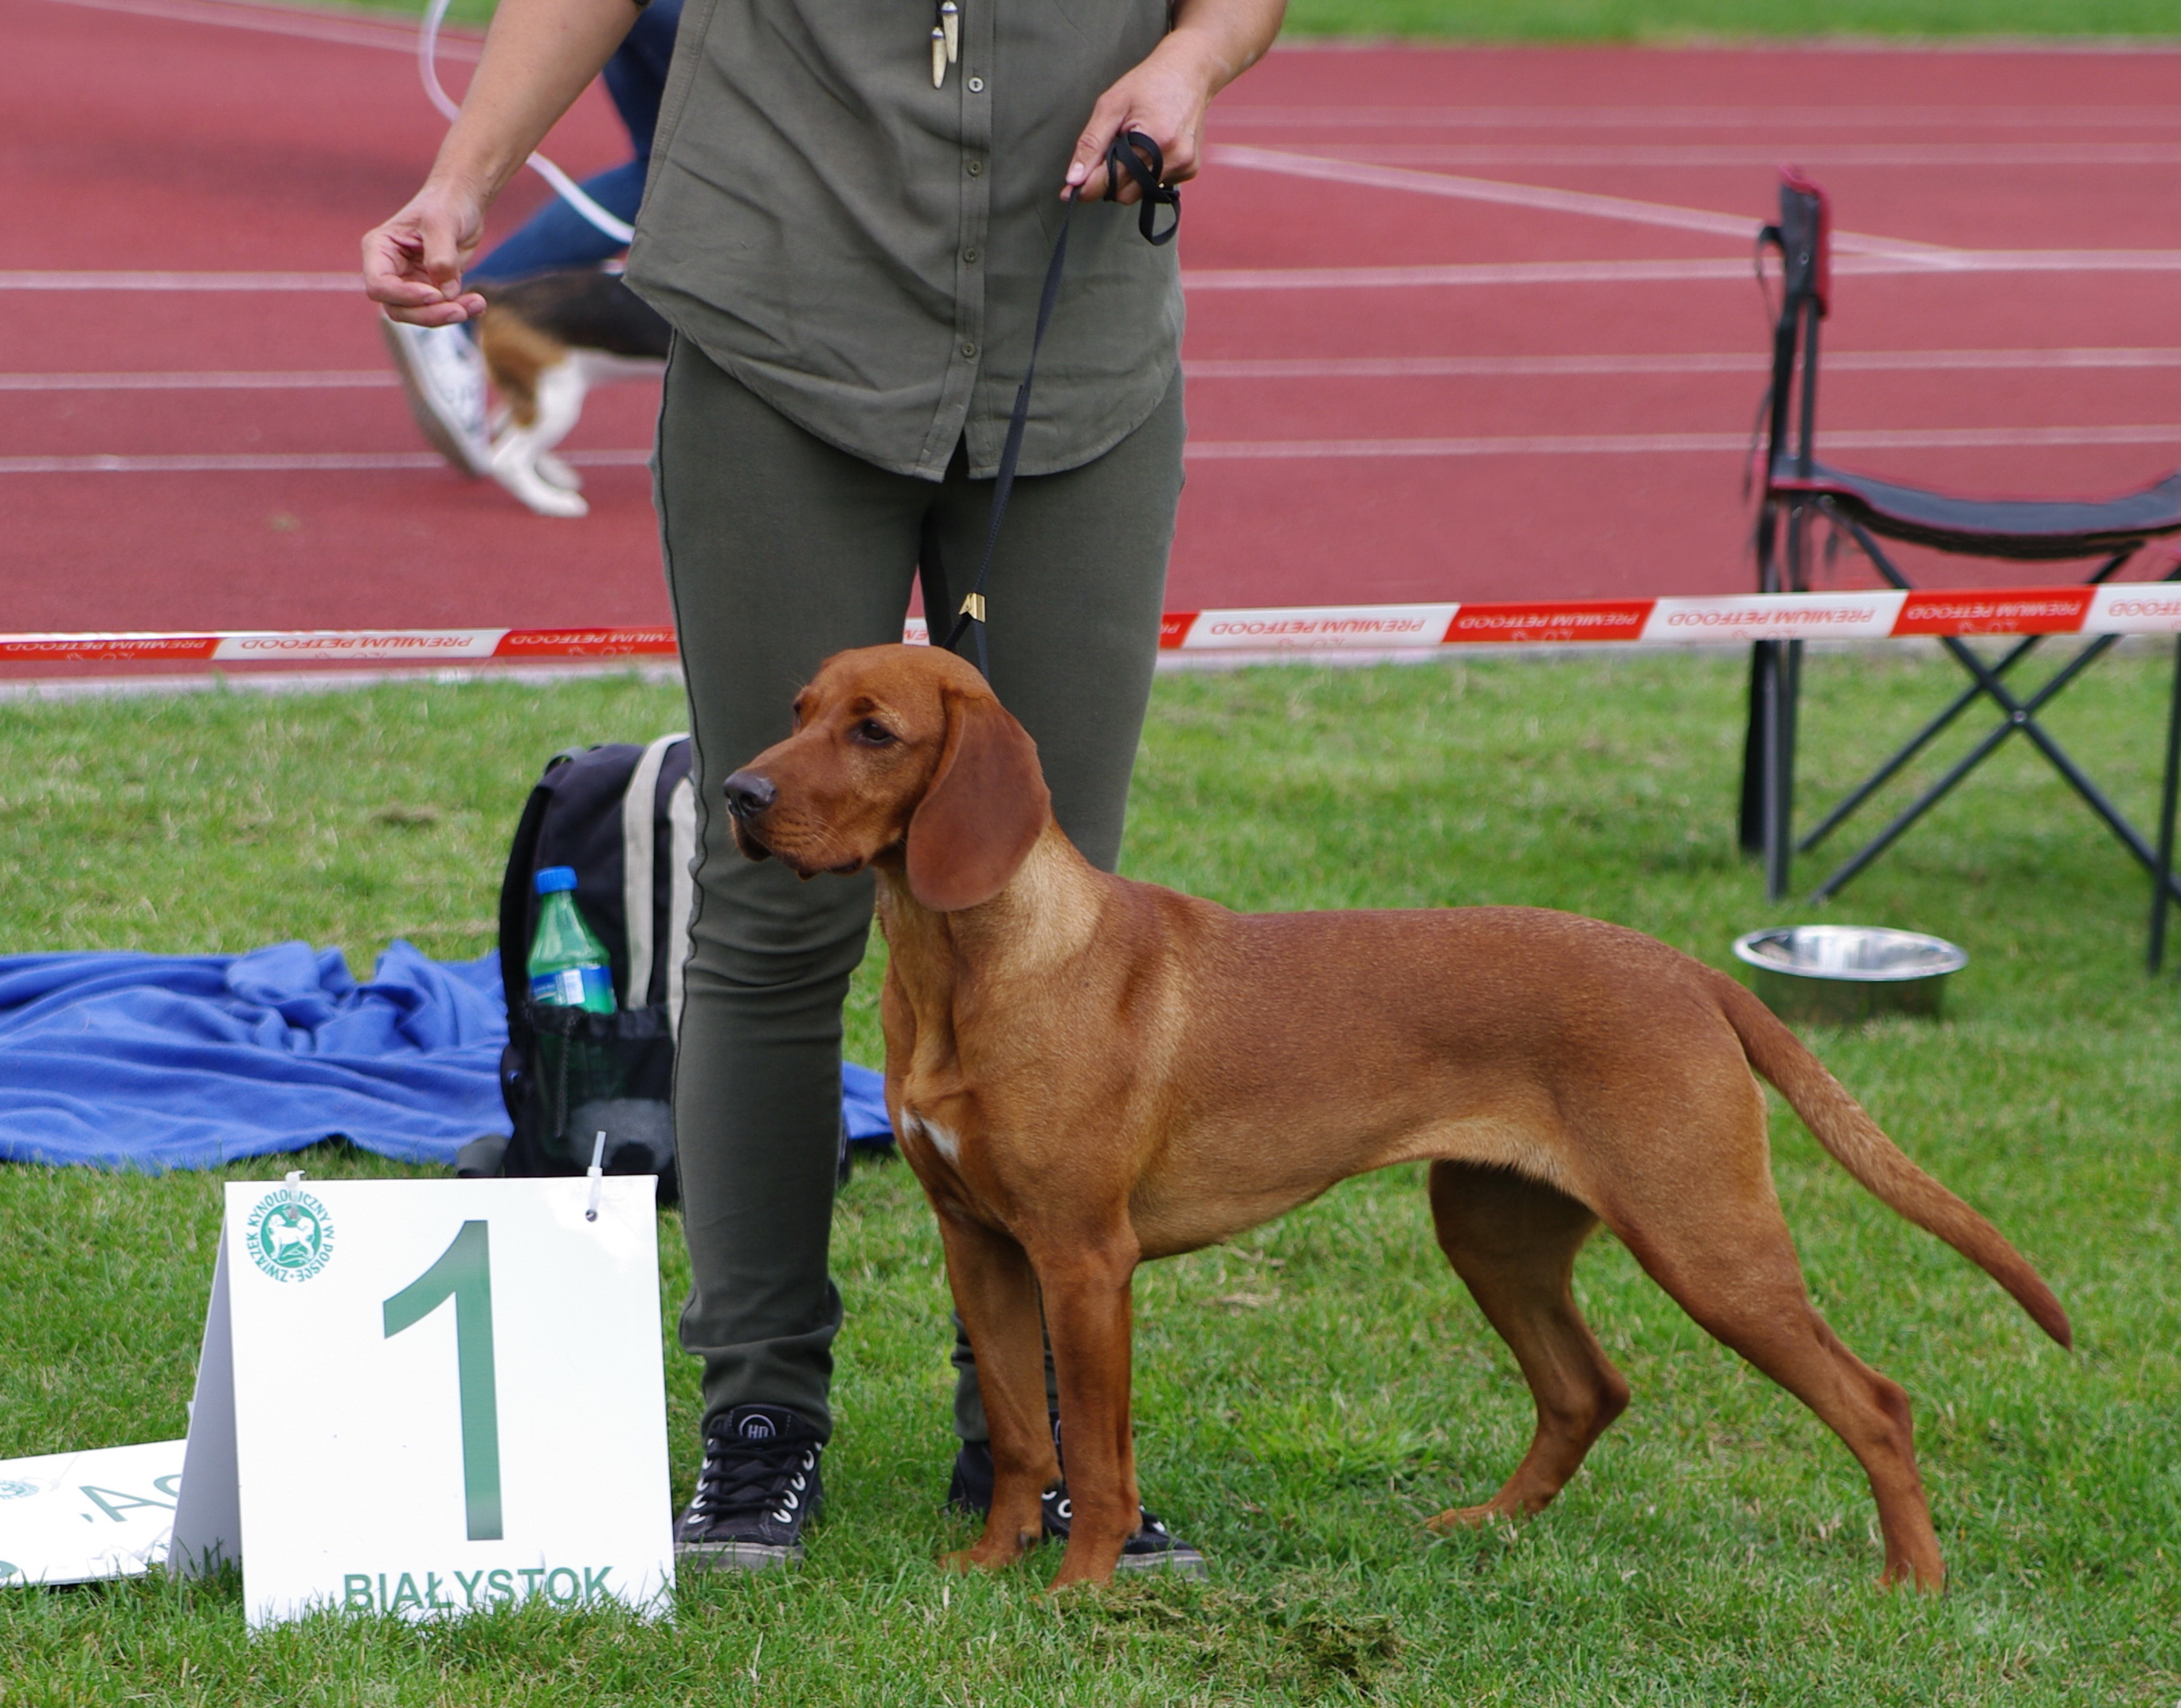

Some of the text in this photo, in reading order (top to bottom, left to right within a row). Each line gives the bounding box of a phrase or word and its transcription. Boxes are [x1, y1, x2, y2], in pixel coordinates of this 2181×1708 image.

[1907, 601, 2081, 618] PREMIUM PETFOOD
[2108, 600, 2181, 616] TFOOD
[1459, 613, 1639, 629] PREMIUM PETFOOD
[1668, 610, 1876, 626] PREMIUM PETFOOD
[1211, 619, 1425, 635] PREMIUM PETFOOD
[6, 639, 207, 652] PREMIUM PETFOOD
[241, 637, 474, 650] PREMIUM PETFOOD
[510, 633, 677, 644] EMIUM PETFOOD
[323, 1224, 335, 1240] W
[296, 1244, 334, 1283] POLSCE
[383, 1220, 503, 1541] 1
[344, 1566, 613, 1611] BIAŁYSTOK
